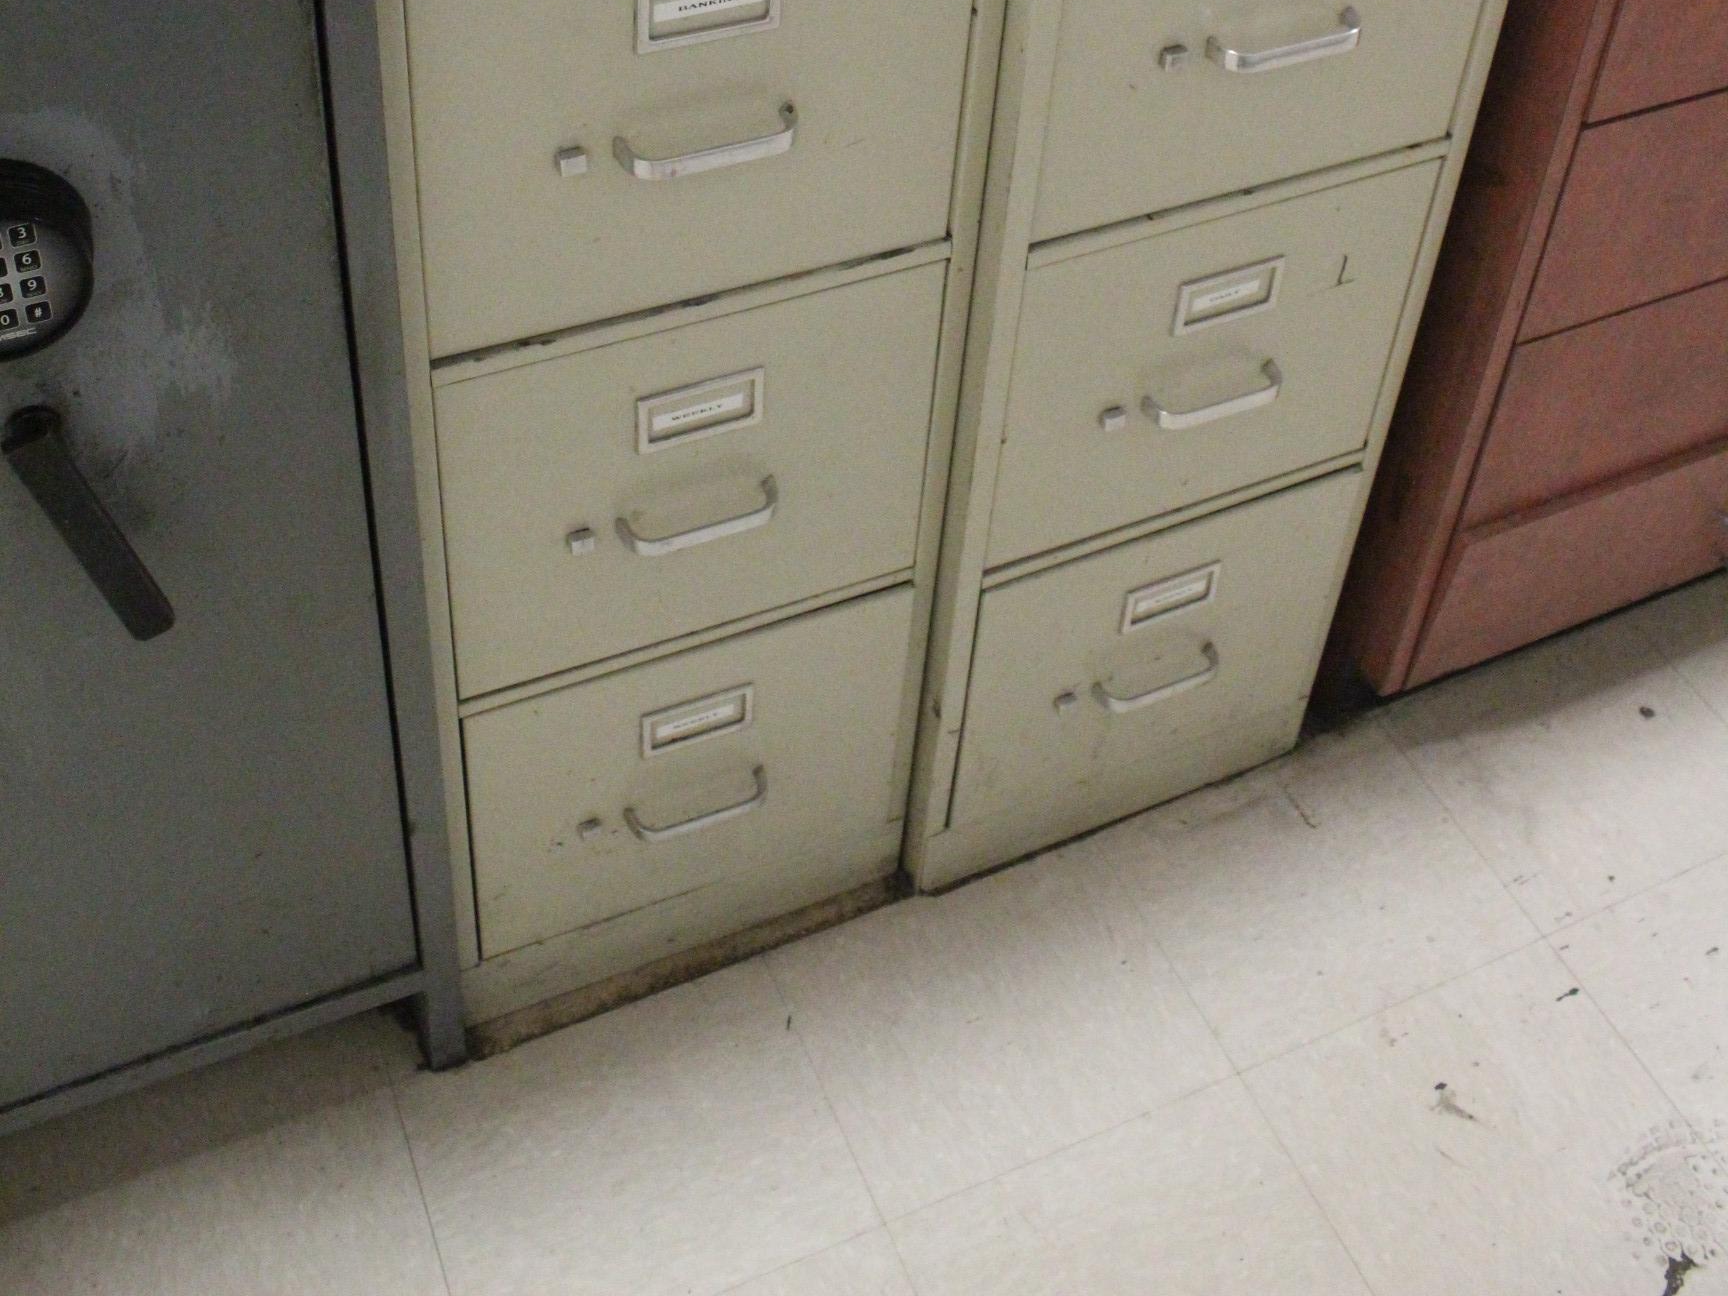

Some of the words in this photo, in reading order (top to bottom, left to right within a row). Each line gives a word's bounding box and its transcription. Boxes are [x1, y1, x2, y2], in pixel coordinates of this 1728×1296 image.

[18, 227, 27, 239] 3
[22, 254, 32, 265] 6
[27, 279, 37, 291] 9
[0, 314, 10, 326] 0
